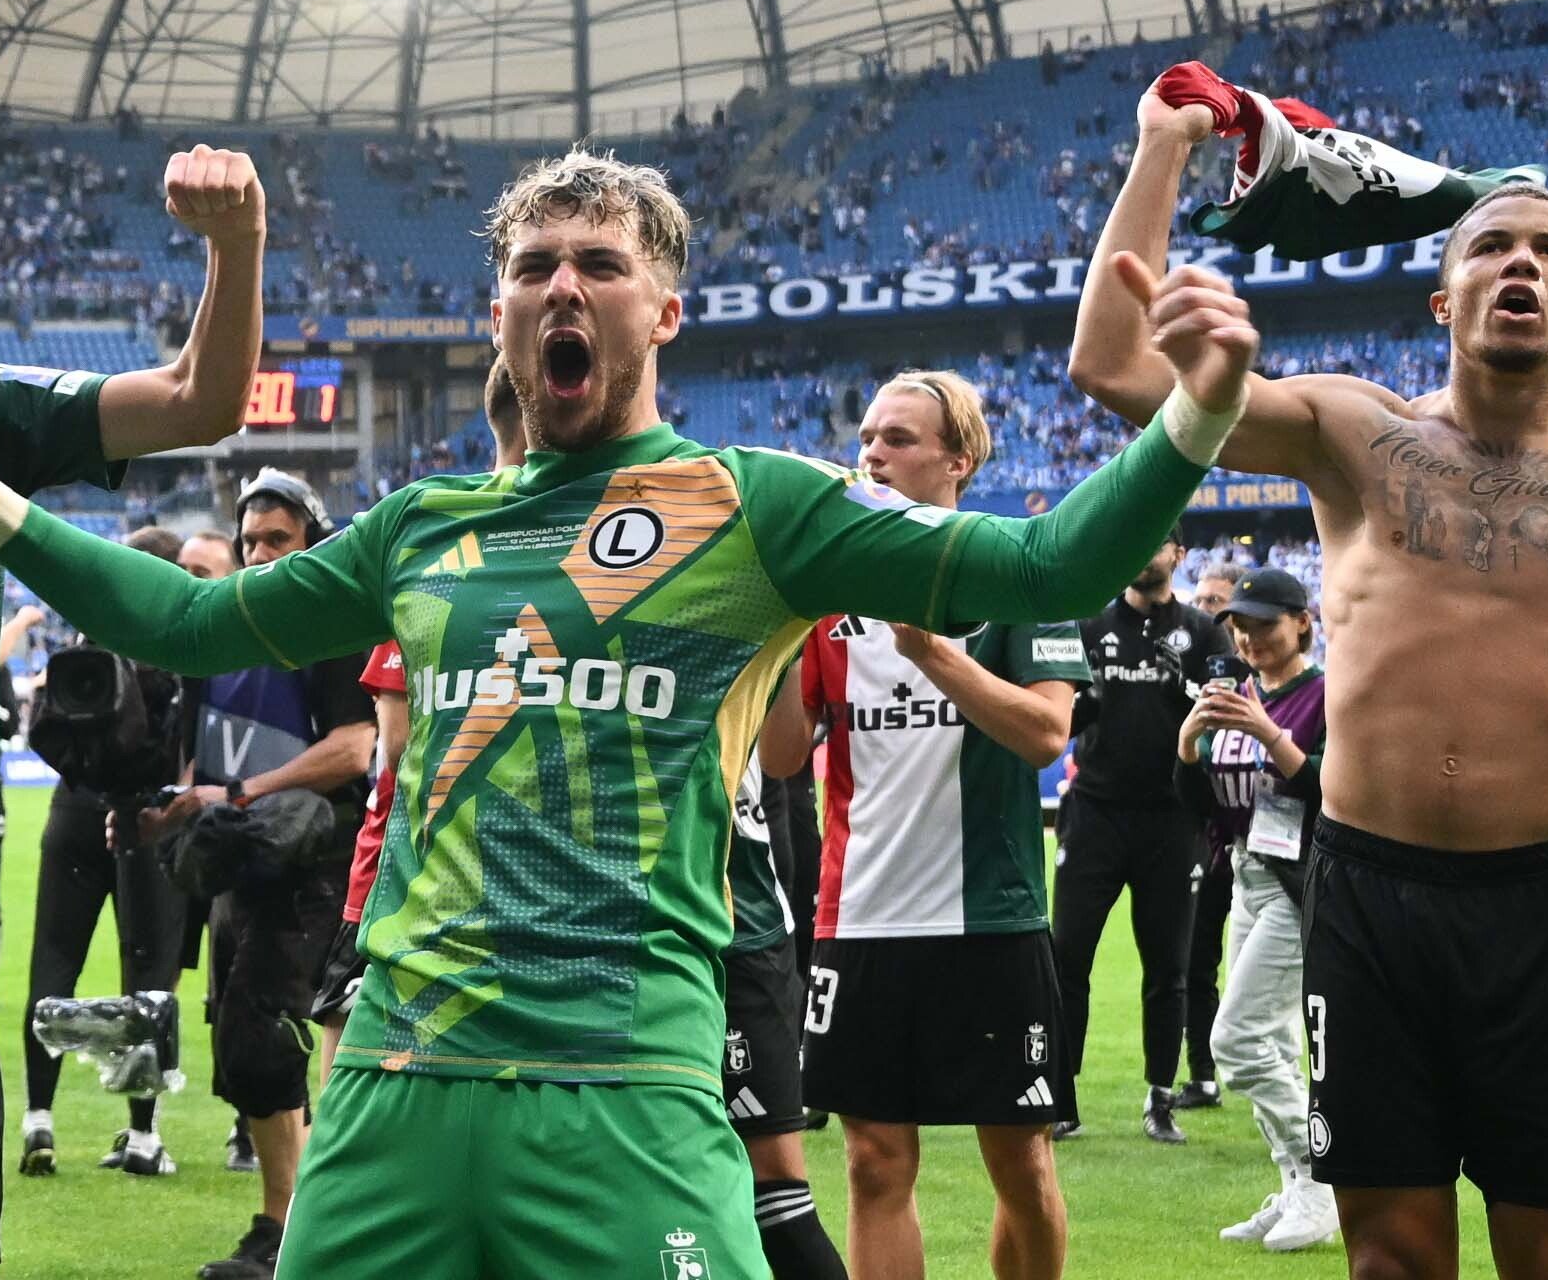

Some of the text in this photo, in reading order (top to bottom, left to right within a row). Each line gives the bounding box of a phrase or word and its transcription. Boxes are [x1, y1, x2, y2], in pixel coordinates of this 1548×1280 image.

[1368, 421, 1463, 478] Never
[1225, 482, 1298, 508] POLSKI
[607, 519, 637, 557] L
[1105, 665, 1160, 682] Plus5
[1307, 993, 1327, 1082] 3
